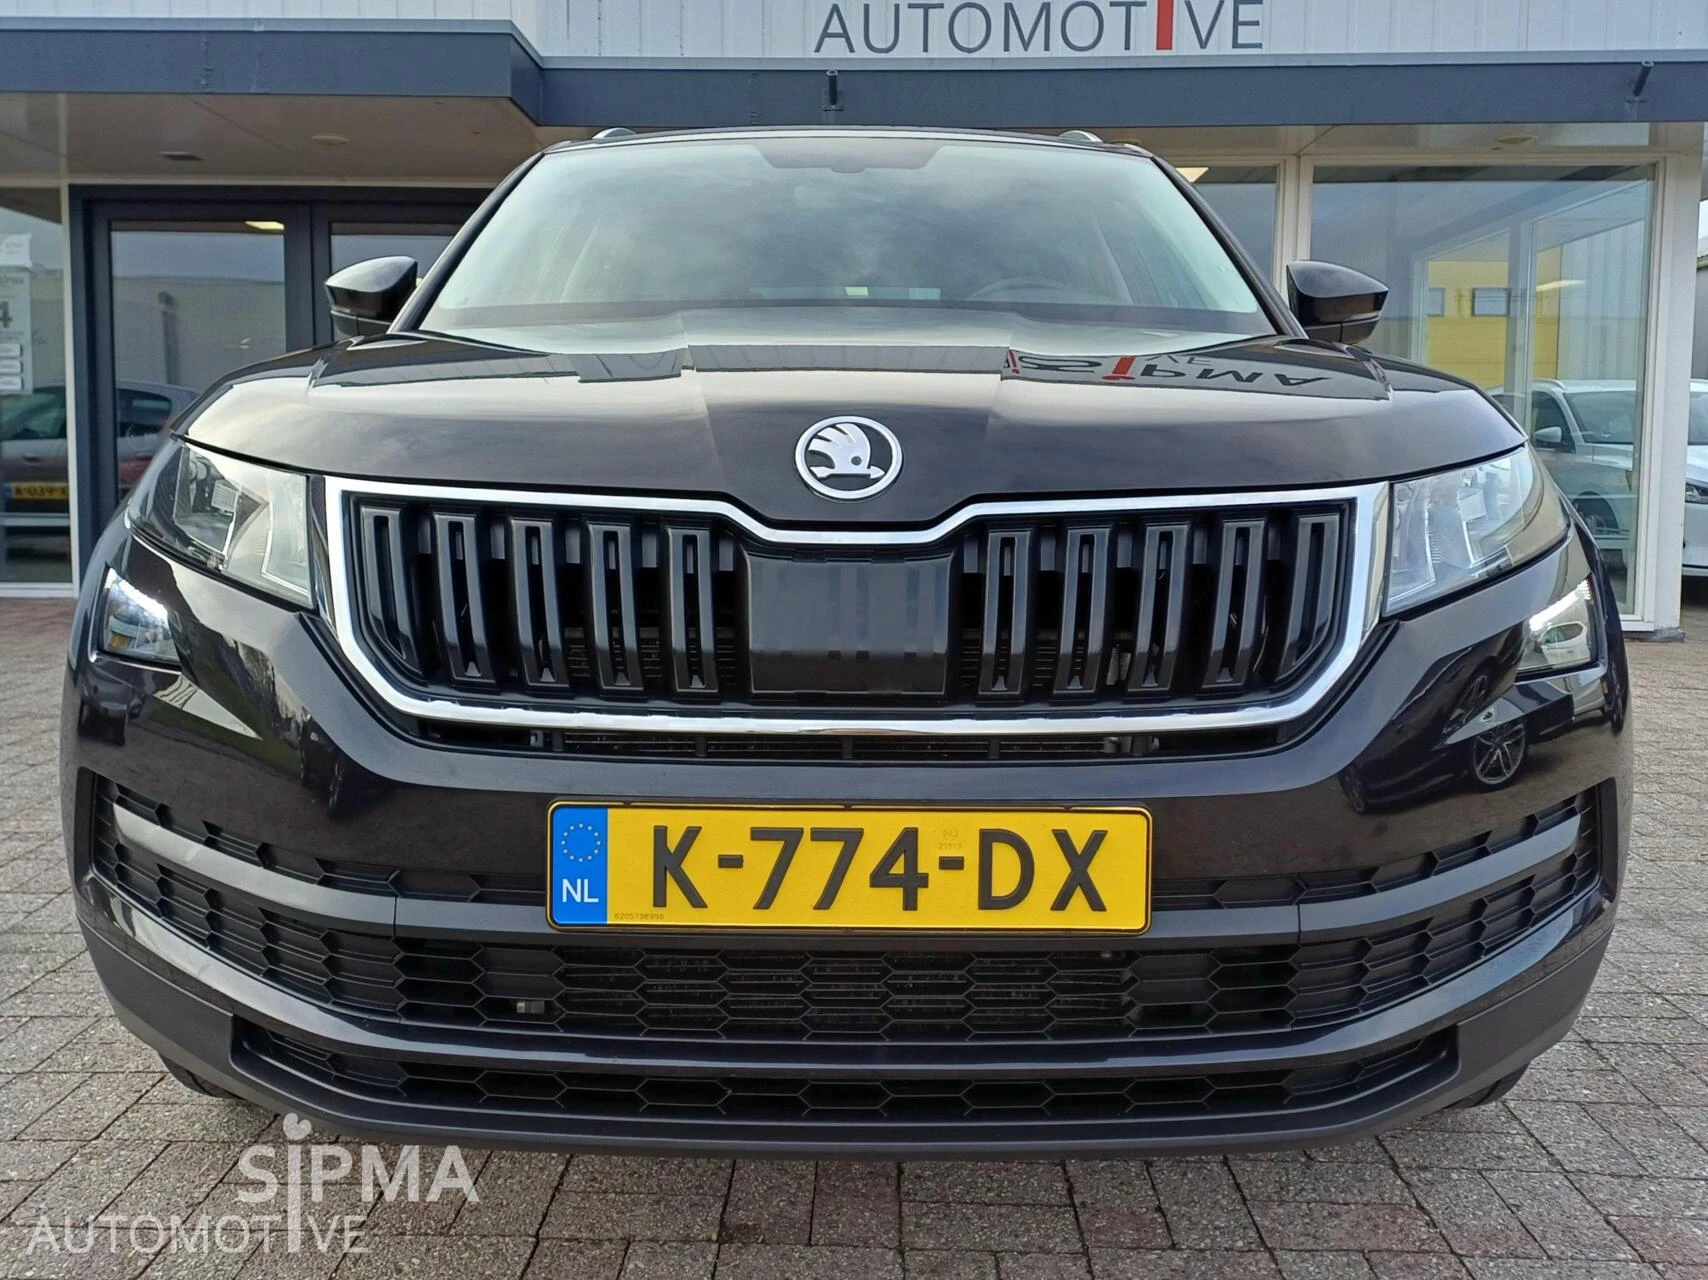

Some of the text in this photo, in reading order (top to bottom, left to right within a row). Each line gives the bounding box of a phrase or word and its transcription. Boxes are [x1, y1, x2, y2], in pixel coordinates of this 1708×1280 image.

[813, 0, 1264, 54] AUTOMOTIVE
[561, 878, 599, 904] NL
[652, 825, 1109, 912] K-774-DX
